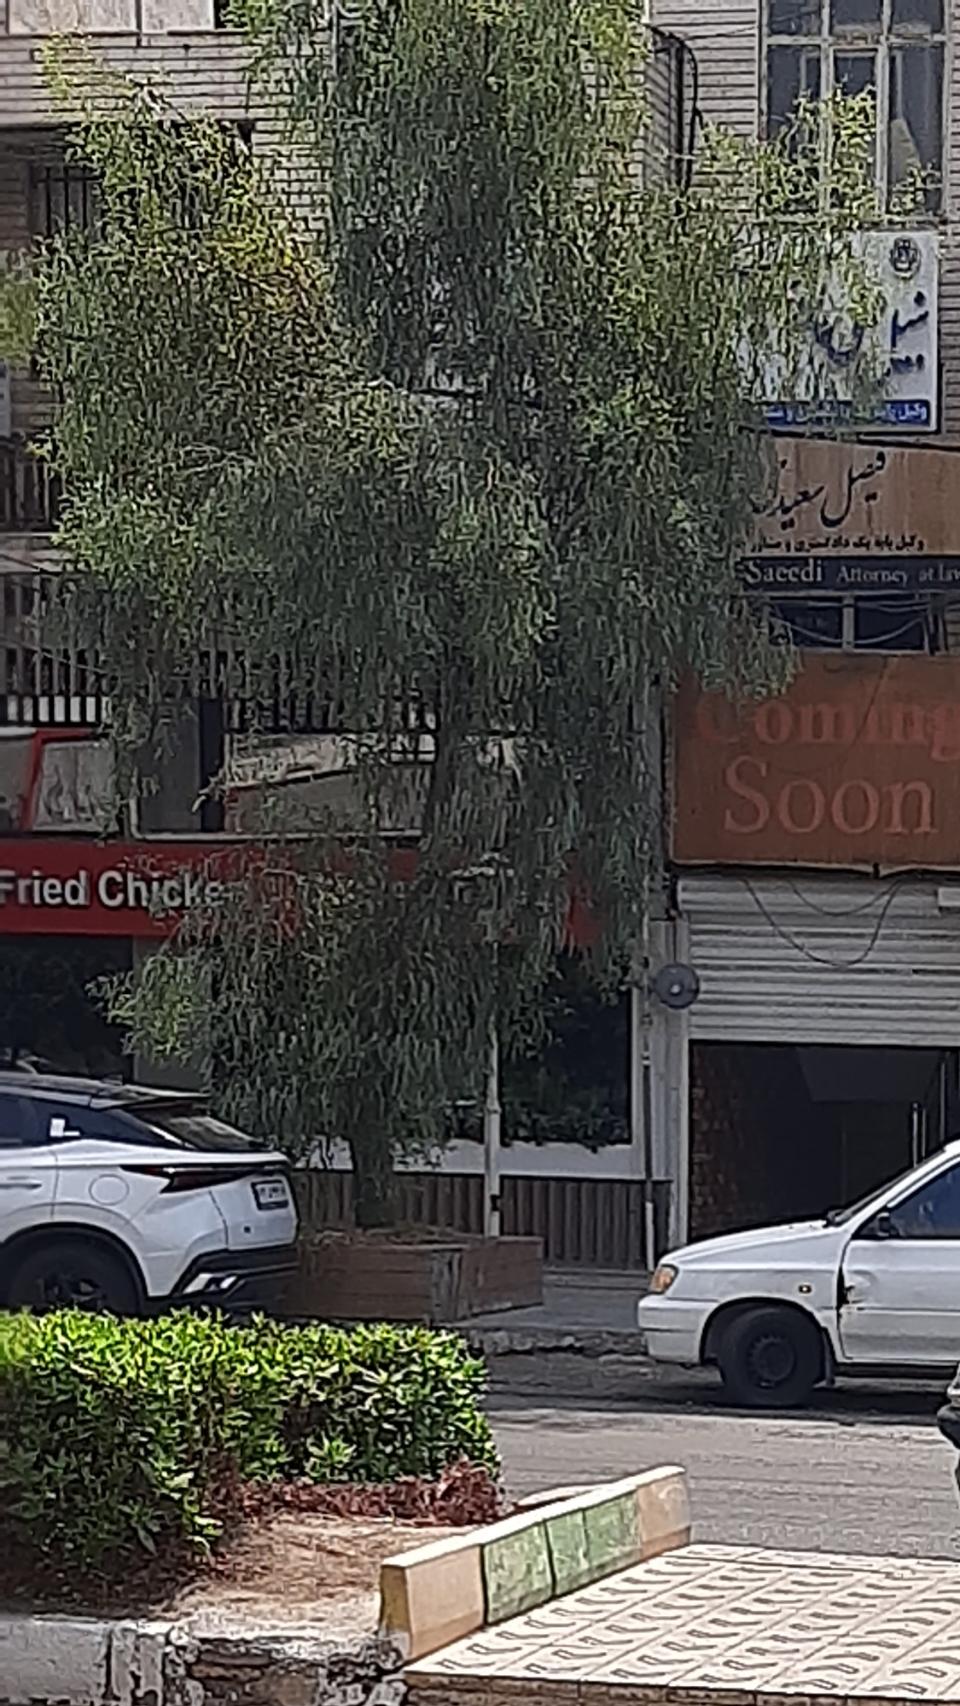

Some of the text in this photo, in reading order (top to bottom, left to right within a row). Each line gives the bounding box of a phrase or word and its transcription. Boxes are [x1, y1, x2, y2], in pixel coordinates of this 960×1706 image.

[745, 558, 823, 583] Saeedi
[836, 565, 909, 588] Attorney
[723, 754, 940, 835] Soon
[0, 869, 228, 908] Fried Chicke
